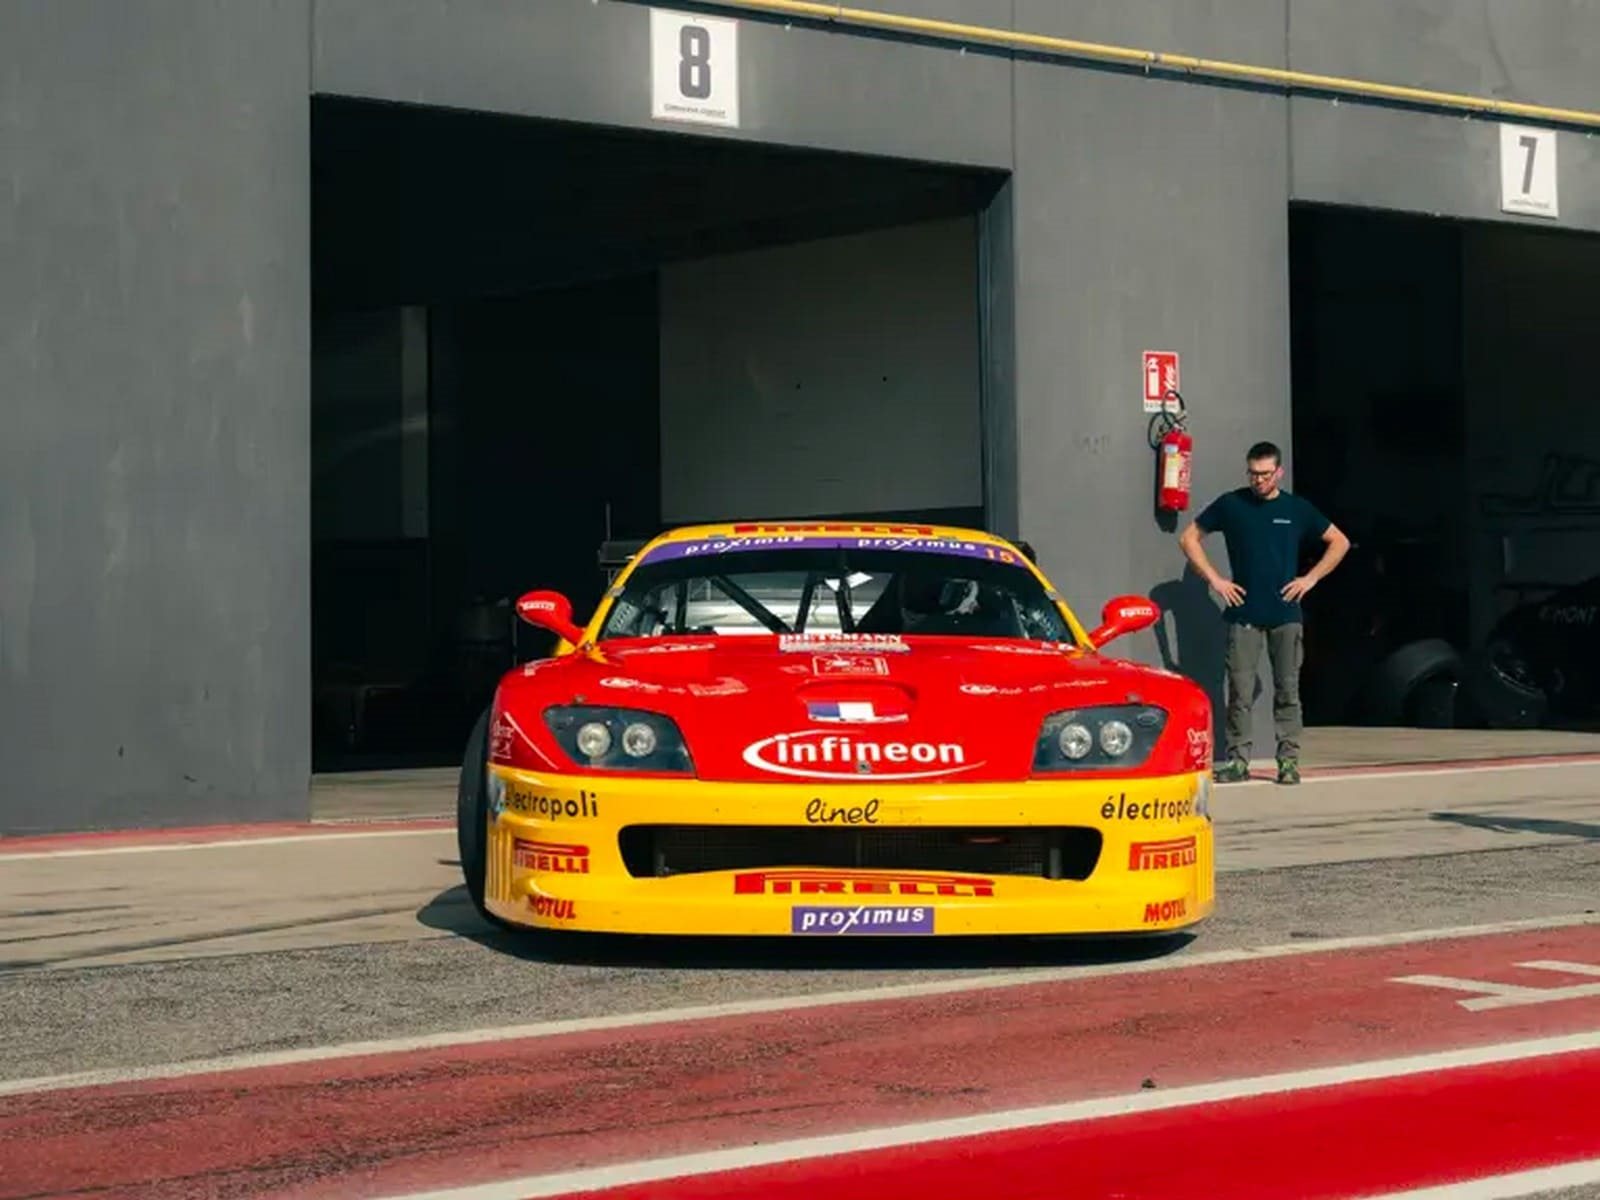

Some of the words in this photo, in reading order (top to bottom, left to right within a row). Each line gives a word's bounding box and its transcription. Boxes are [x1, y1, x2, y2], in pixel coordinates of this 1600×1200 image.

[679, 25, 711, 100] 8
[1519, 135, 1538, 194] 7
[684, 536, 805, 555] proximus
[858, 537, 976, 550] proximus
[985, 548, 1015, 564] 15
[774, 733, 966, 764] infineon
[806, 799, 880, 824] linel
[1129, 835, 1197, 871] PIRELLI
[734, 870, 995, 896] PIRELLI
[801, 905, 926, 934] proximus
